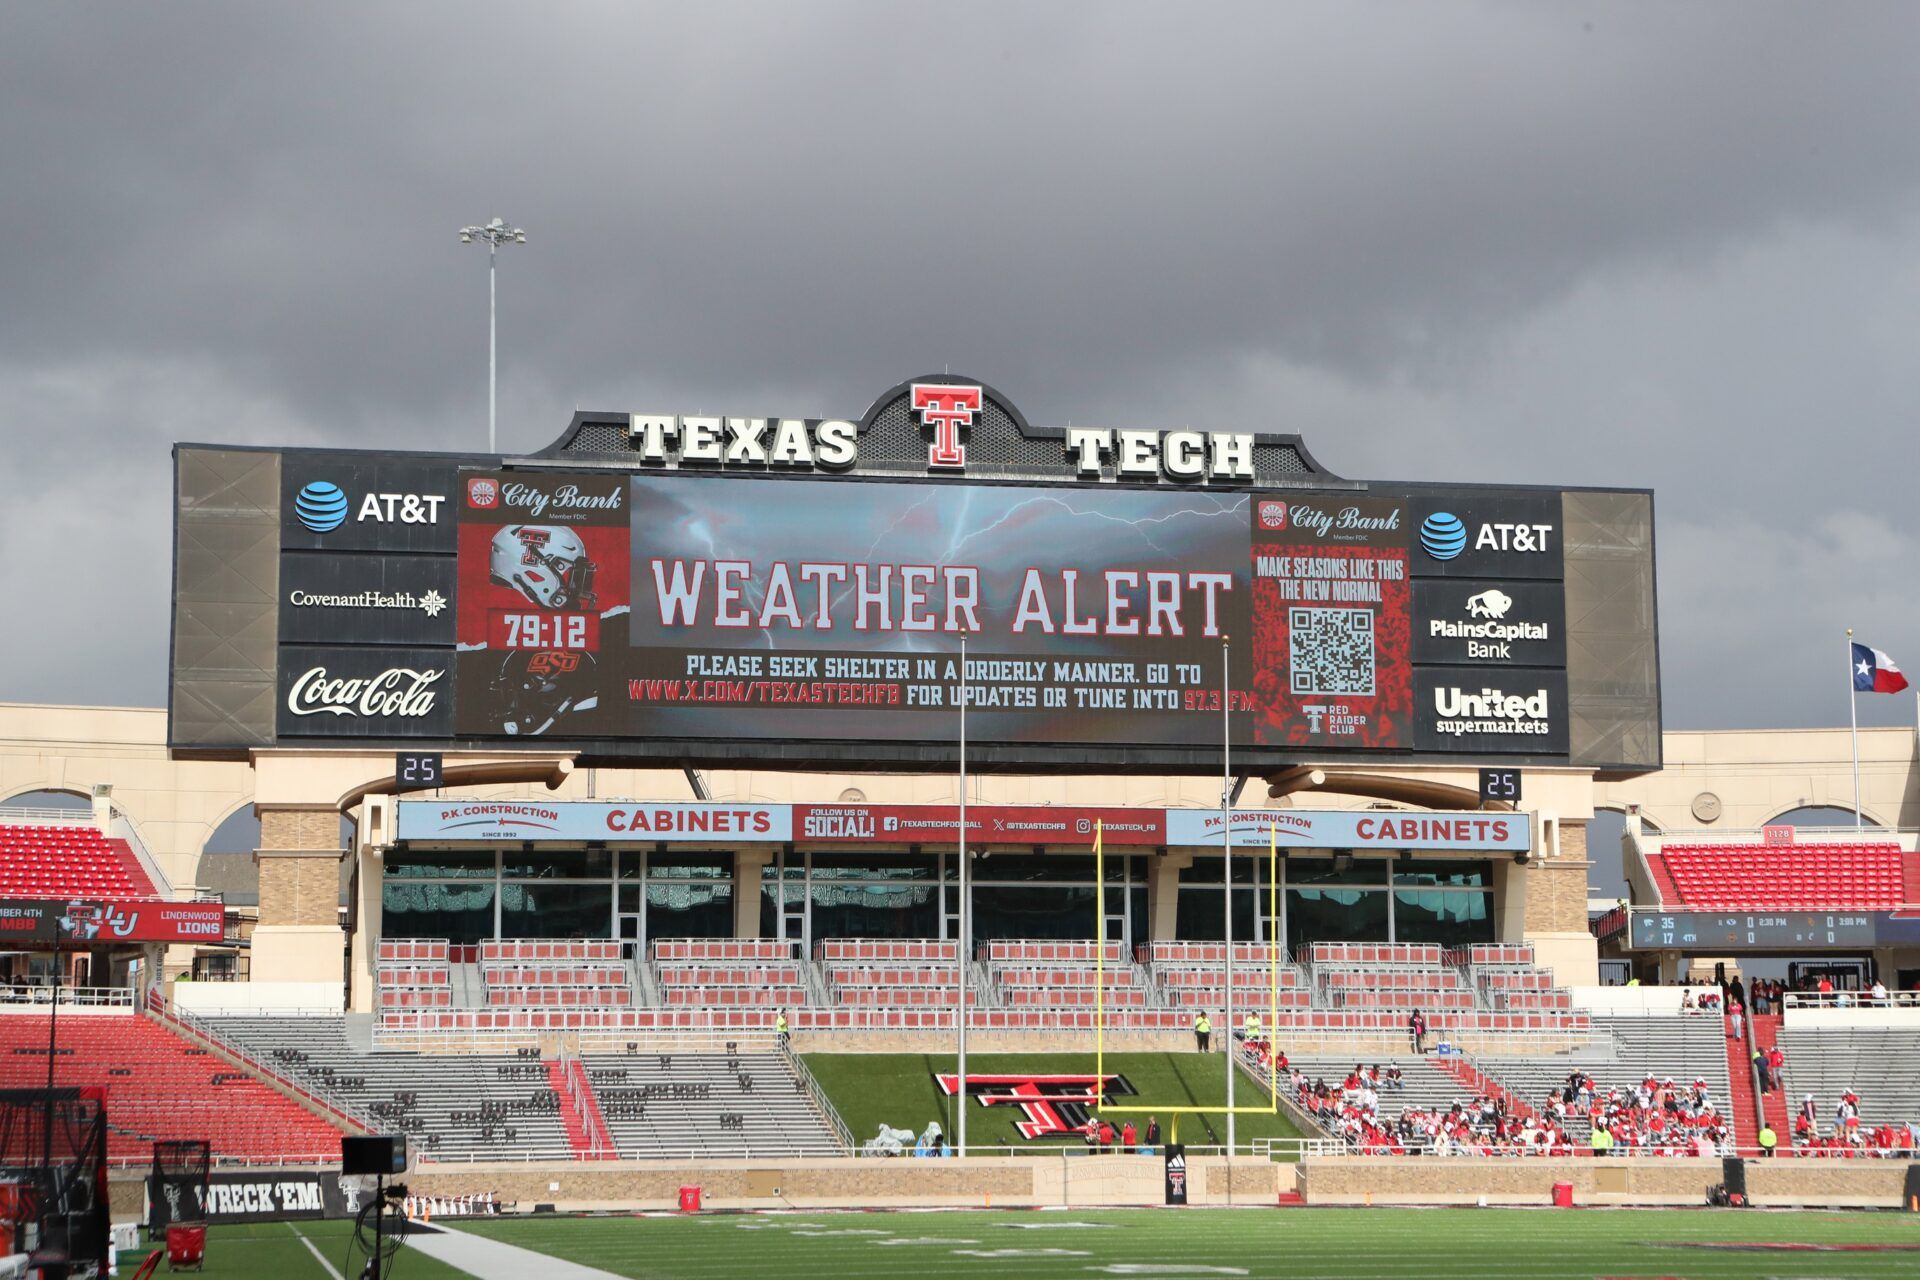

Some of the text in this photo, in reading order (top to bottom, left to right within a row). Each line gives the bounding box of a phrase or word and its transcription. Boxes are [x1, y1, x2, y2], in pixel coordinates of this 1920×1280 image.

[630, 414, 857, 466] TEXAS
[1067, 427, 1254, 480] TECH
[357, 493, 446, 524] AT&T
[502, 483, 622, 516] City Bank
[1289, 505, 1399, 537] City Bank
[1475, 523, 1552, 552] AT&T
[1257, 556, 1404, 580] MAKE SEASONS LIKE THIS
[290, 590, 416, 609] CovenantHealth
[651, 559, 1232, 636] WEATHER ALERT
[1279, 579, 1382, 602] THE NEW NORMAL
[504, 614, 586, 648] 79:12
[1430, 620, 1548, 642] PlainsCapital
[1467, 641, 1511, 659] Bank
[686, 654, 1201, 685] PLEASE SEEK SHELTER IN A ORDERLY MANNER. GO TO
[287, 666, 446, 717] Coca-Cola
[628, 679, 1256, 712] WWW.X.COM/TEXASTECHFB FOR UPDATES OR TUNE INTO 97.3 FM
[1330, 705, 1348, 714] RED
[1434, 687, 1548, 719] United
[1330, 715, 1366, 725] RAIDER
[1330, 724, 1355, 735] CLUB
[1436, 717, 1549, 736] supermarkets
[404, 758, 434, 781] 25
[1487, 773, 1515, 796] 25
[441, 805, 559, 821] P.K. CONSTRUCTION
[606, 809, 771, 833] CABINETS
[810, 808, 842, 816] FOLLOW
[1204, 813, 1312, 829] P.K. ONSTRUCTION
[804, 816, 875, 838] SOCIAL!
[900, 820, 982, 828] /TEXASTECHFOOBALL
[1356, 818, 1509, 843] CABINETS
[24, 909, 42, 918] 4TH
[160, 910, 220, 921] LINDENWOOD
[1662, 917, 1674, 929] 35
[1776, 918, 1787, 926] PM
[1856, 917, 1867, 926] PM
[177, 922, 220, 934] LIONS
[1663, 932, 1674, 944] 17
